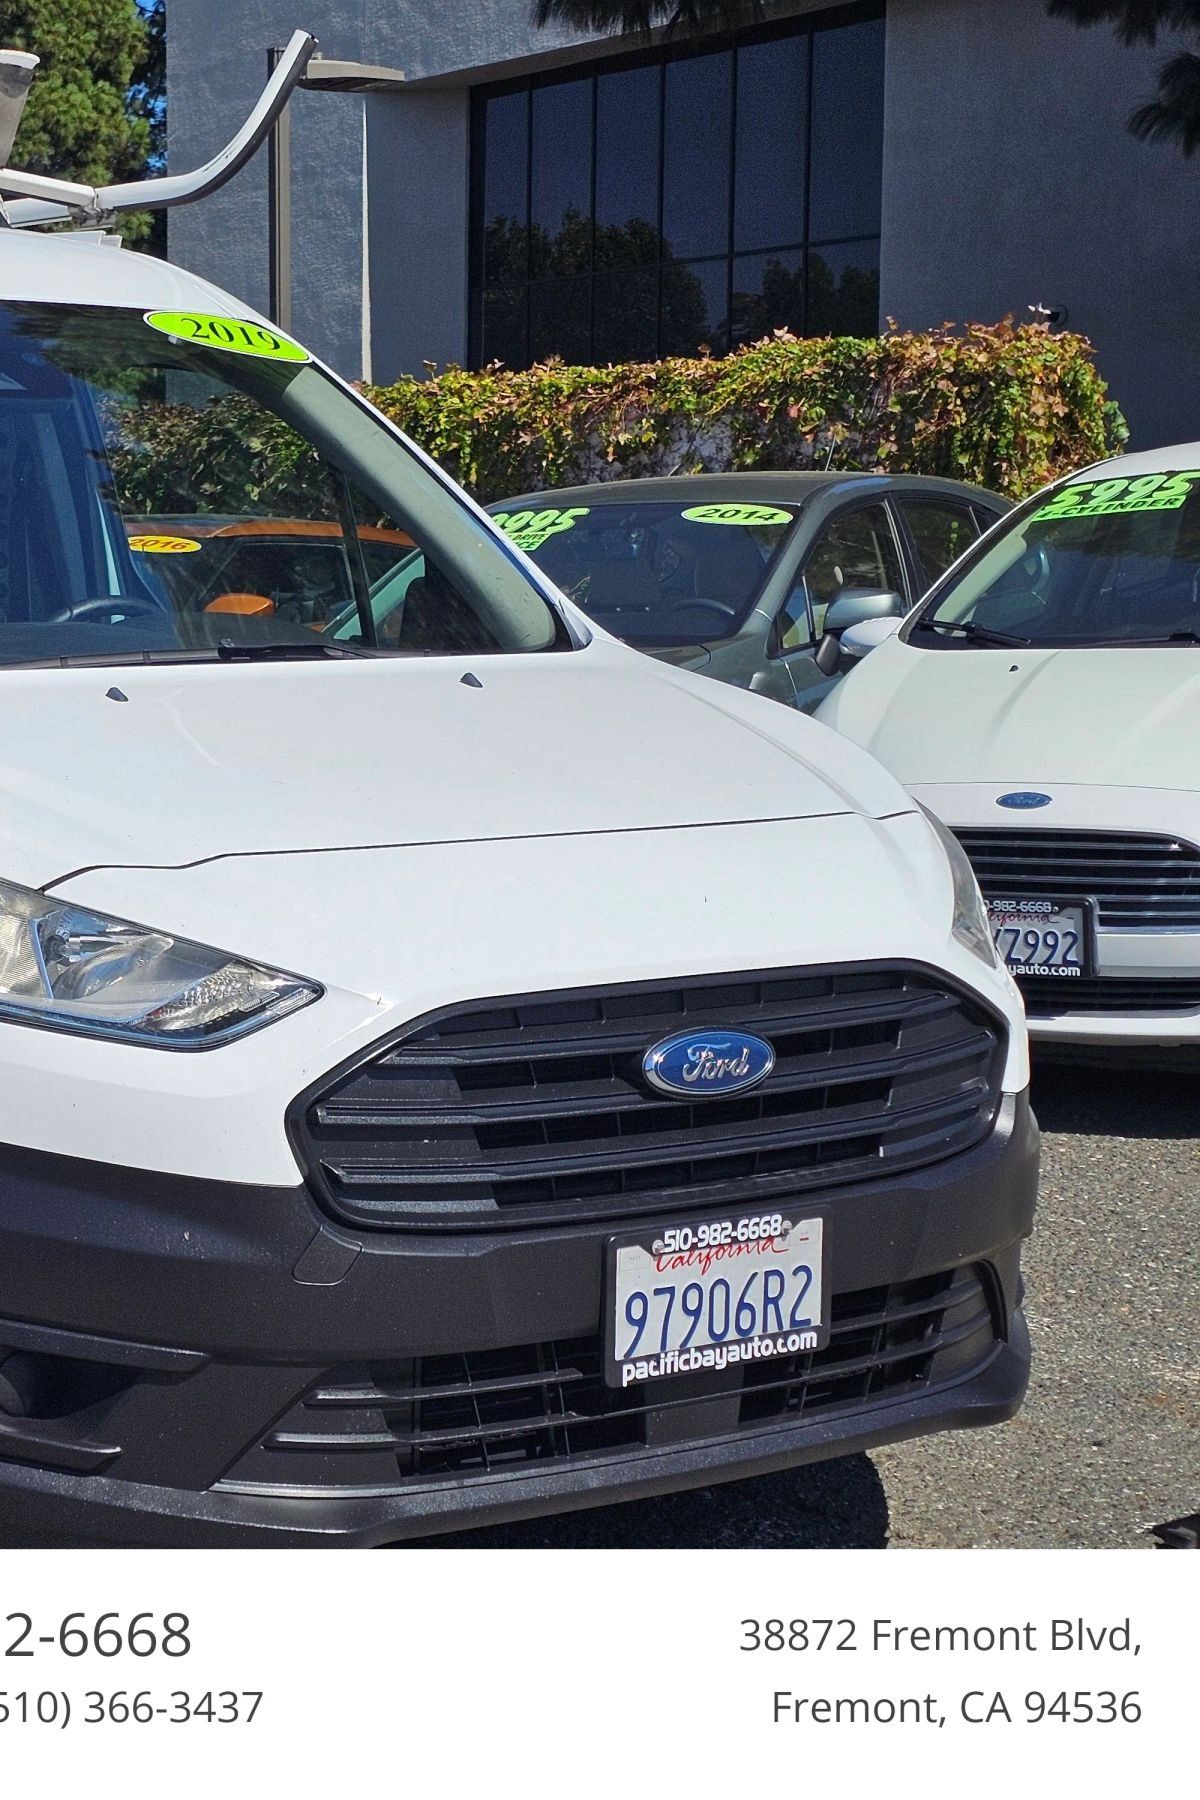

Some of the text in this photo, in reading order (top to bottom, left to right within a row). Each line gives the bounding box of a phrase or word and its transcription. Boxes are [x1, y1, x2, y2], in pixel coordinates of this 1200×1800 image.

[180, 317, 281, 350] 2019
[695, 508, 780, 521] 2014
[129, 538, 191, 550] 2016
[682, 1042, 752, 1082] Ford
[663, 1214, 783, 1254] 510-982-6668
[656, 1235, 790, 1276] California
[623, 1264, 813, 1360] 97906R2
[622, 1330, 818, 1388] pacificbayauto.com
